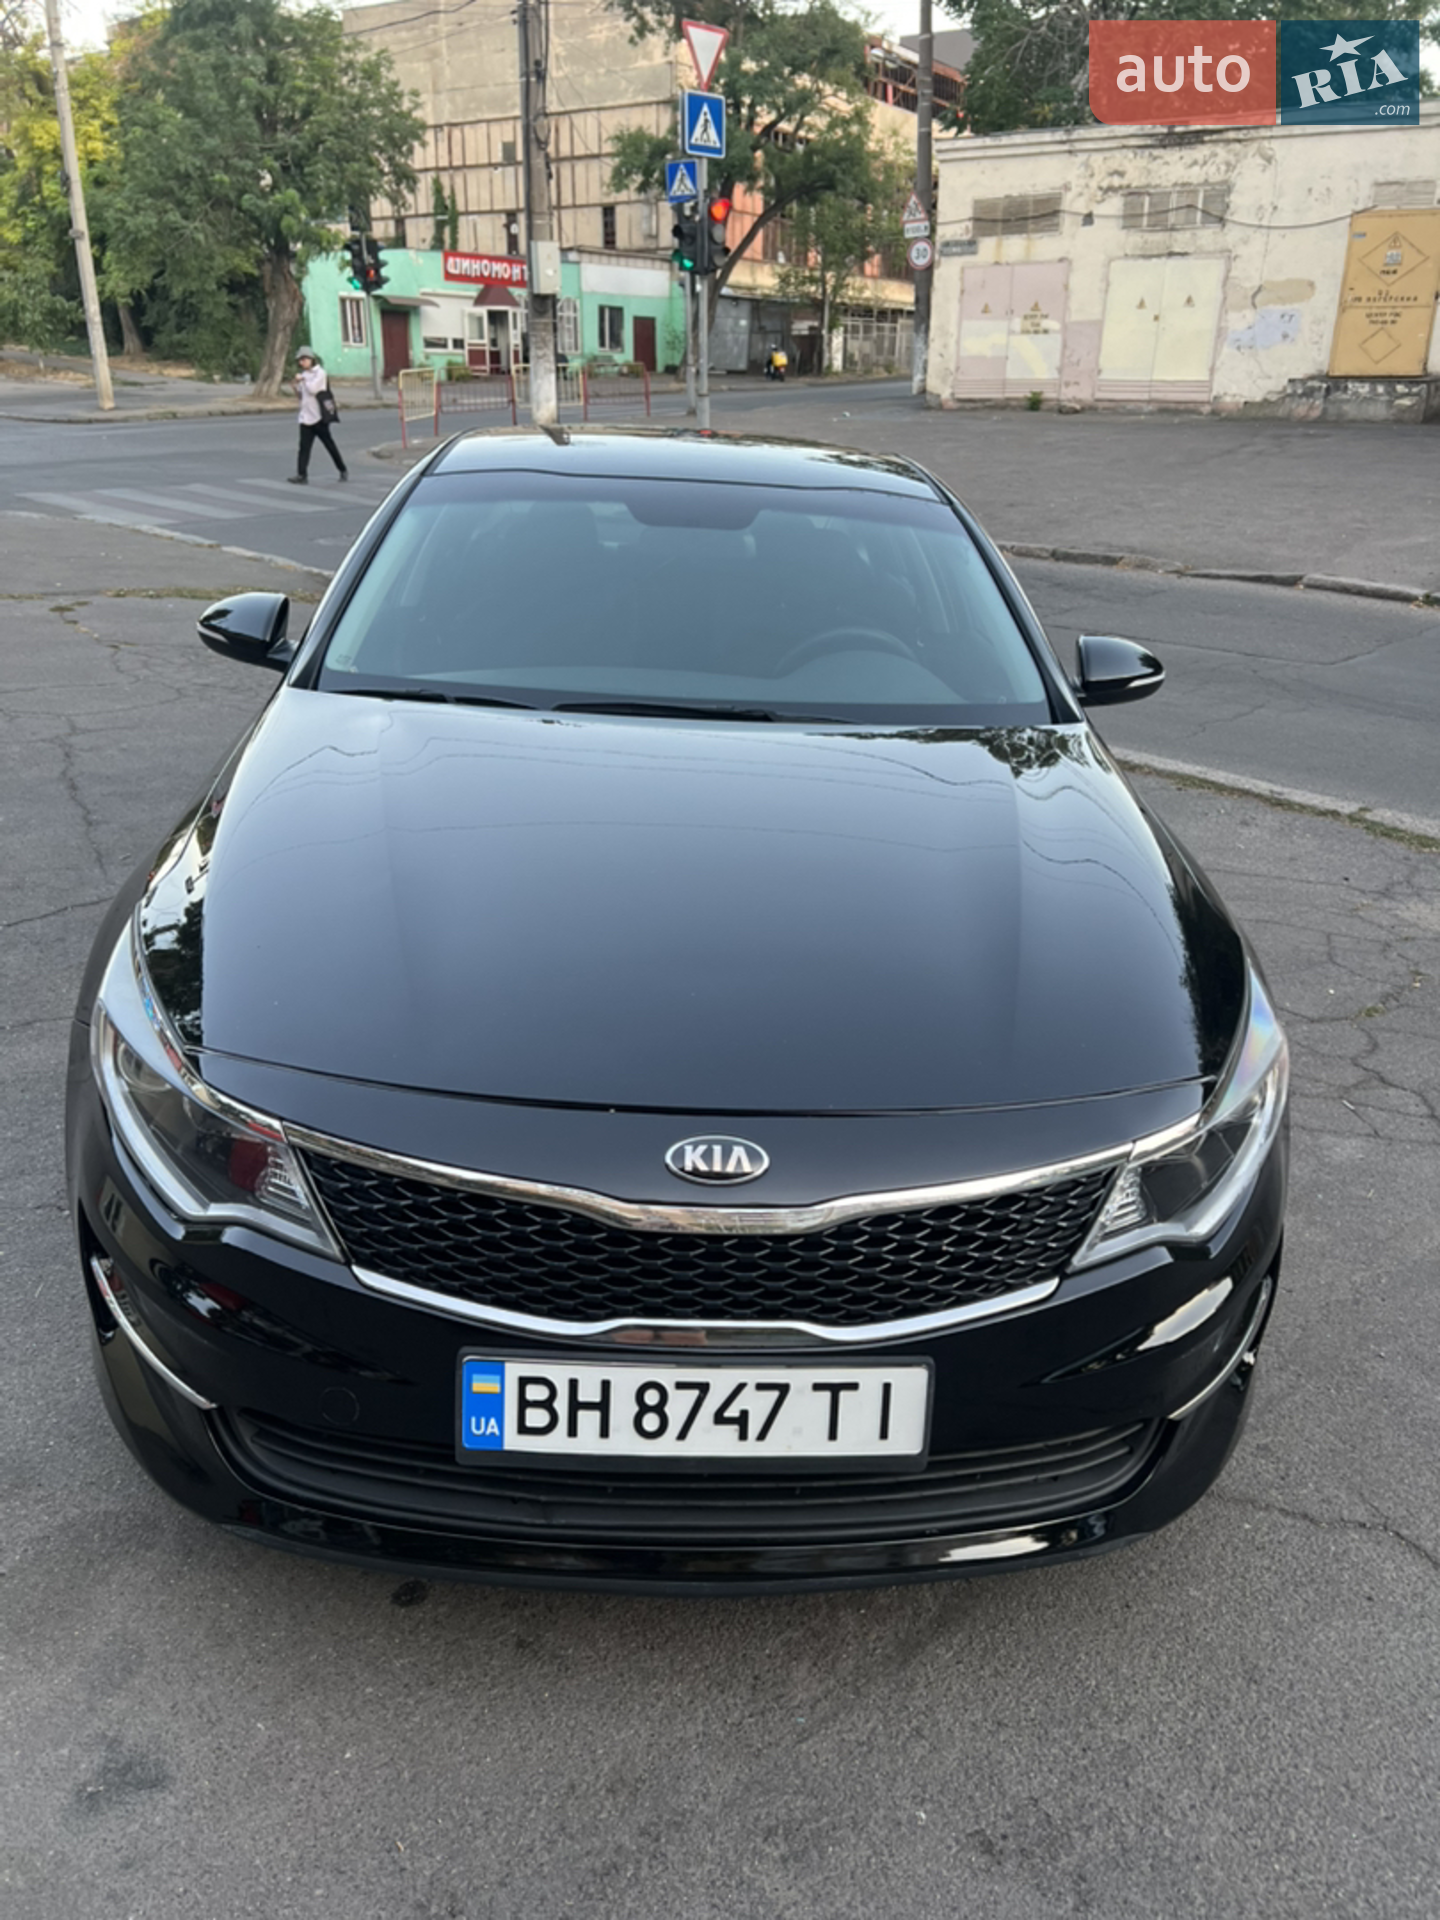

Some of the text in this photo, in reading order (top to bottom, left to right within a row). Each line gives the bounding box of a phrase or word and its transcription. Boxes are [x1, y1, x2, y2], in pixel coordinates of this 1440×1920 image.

[914, 246, 929, 261] 30
[684, 1144, 752, 1173] KIA
[516, 1375, 611, 1439] BH
[633, 1380, 791, 1442] 8747
[471, 1416, 499, 1437] UA
